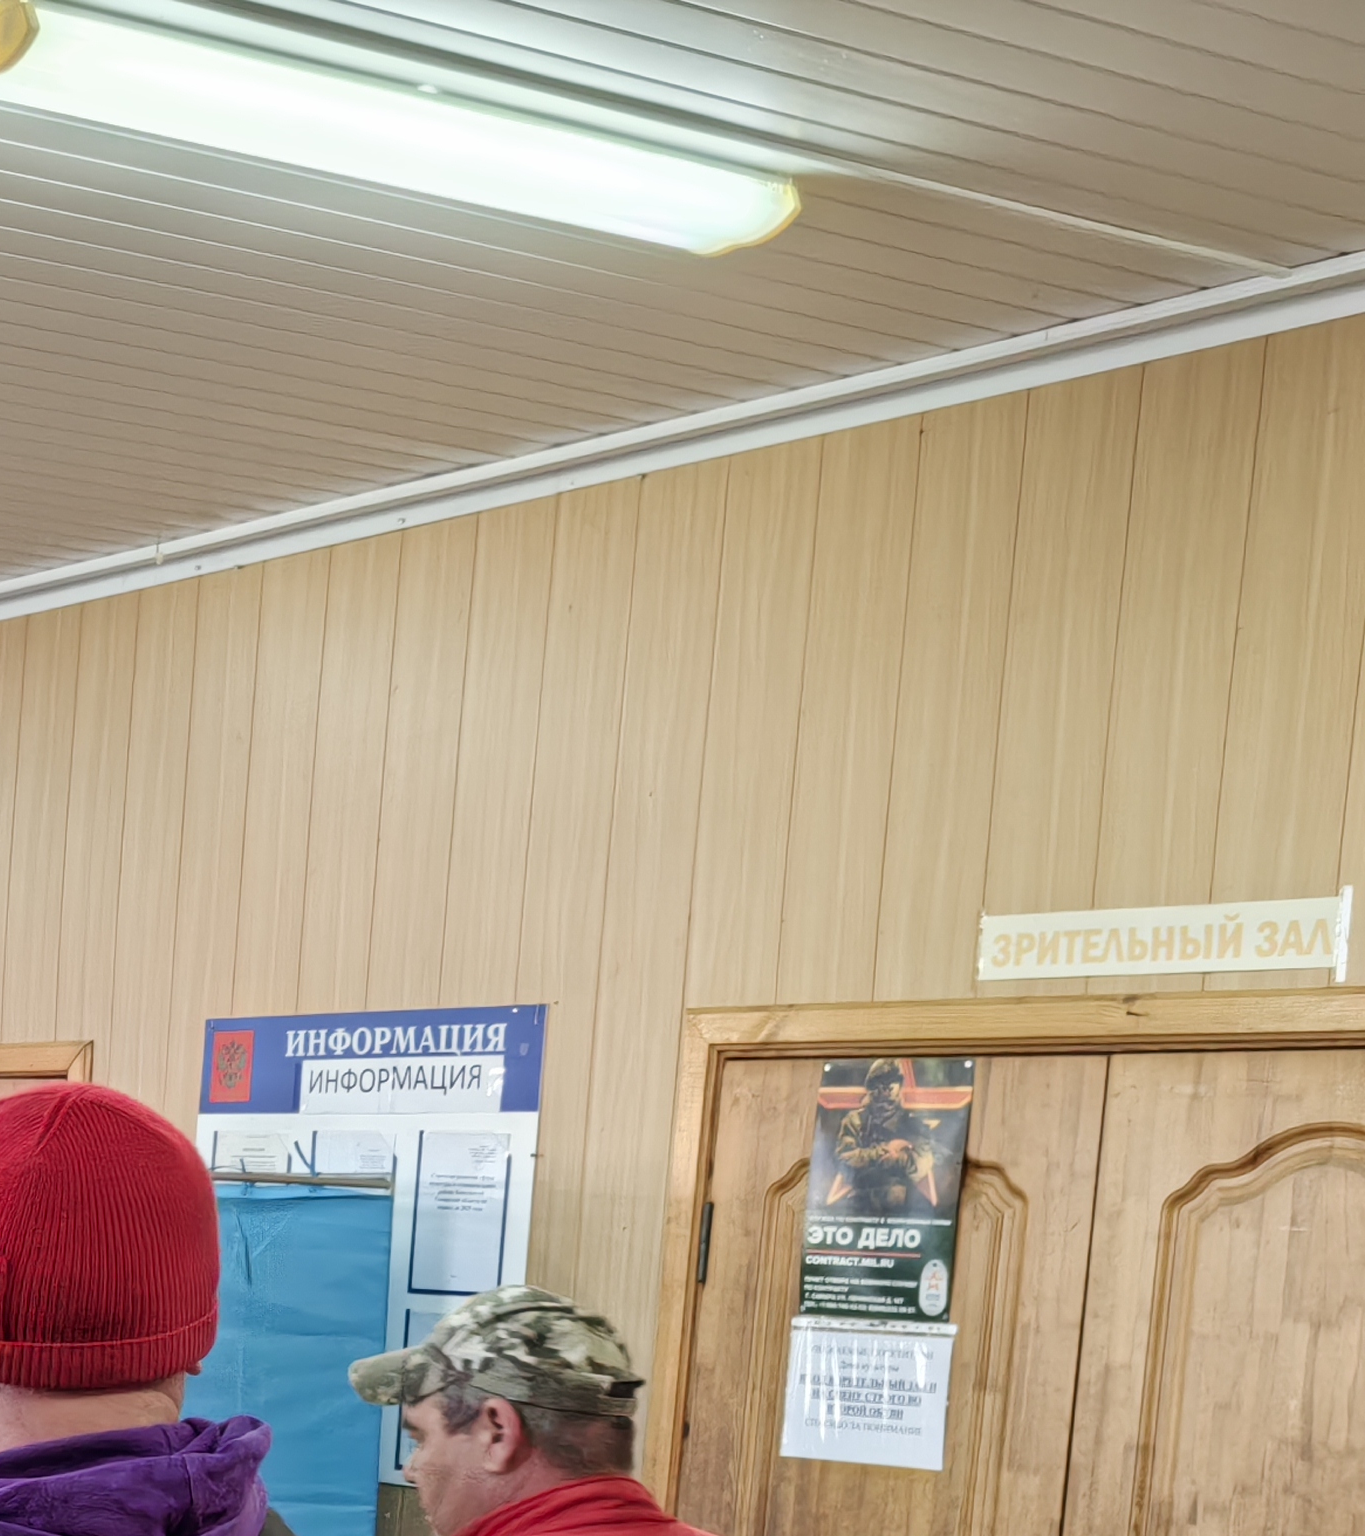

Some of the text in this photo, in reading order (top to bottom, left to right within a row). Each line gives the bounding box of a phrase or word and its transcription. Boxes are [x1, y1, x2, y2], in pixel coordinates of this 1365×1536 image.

[990, 912, 1334, 968] ЗРИТЕЛЬНЫЙ ЗАЛ
[284, 1023, 508, 1057] ИНФОРМАЦИЯ
[308, 1064, 483, 1095] ИНФОРМАЦИЯ
[807, 1226, 922, 1249] ЭТО ДЕЛО
[805, 1255, 895, 1268] CONTRACT.MIL.RU
